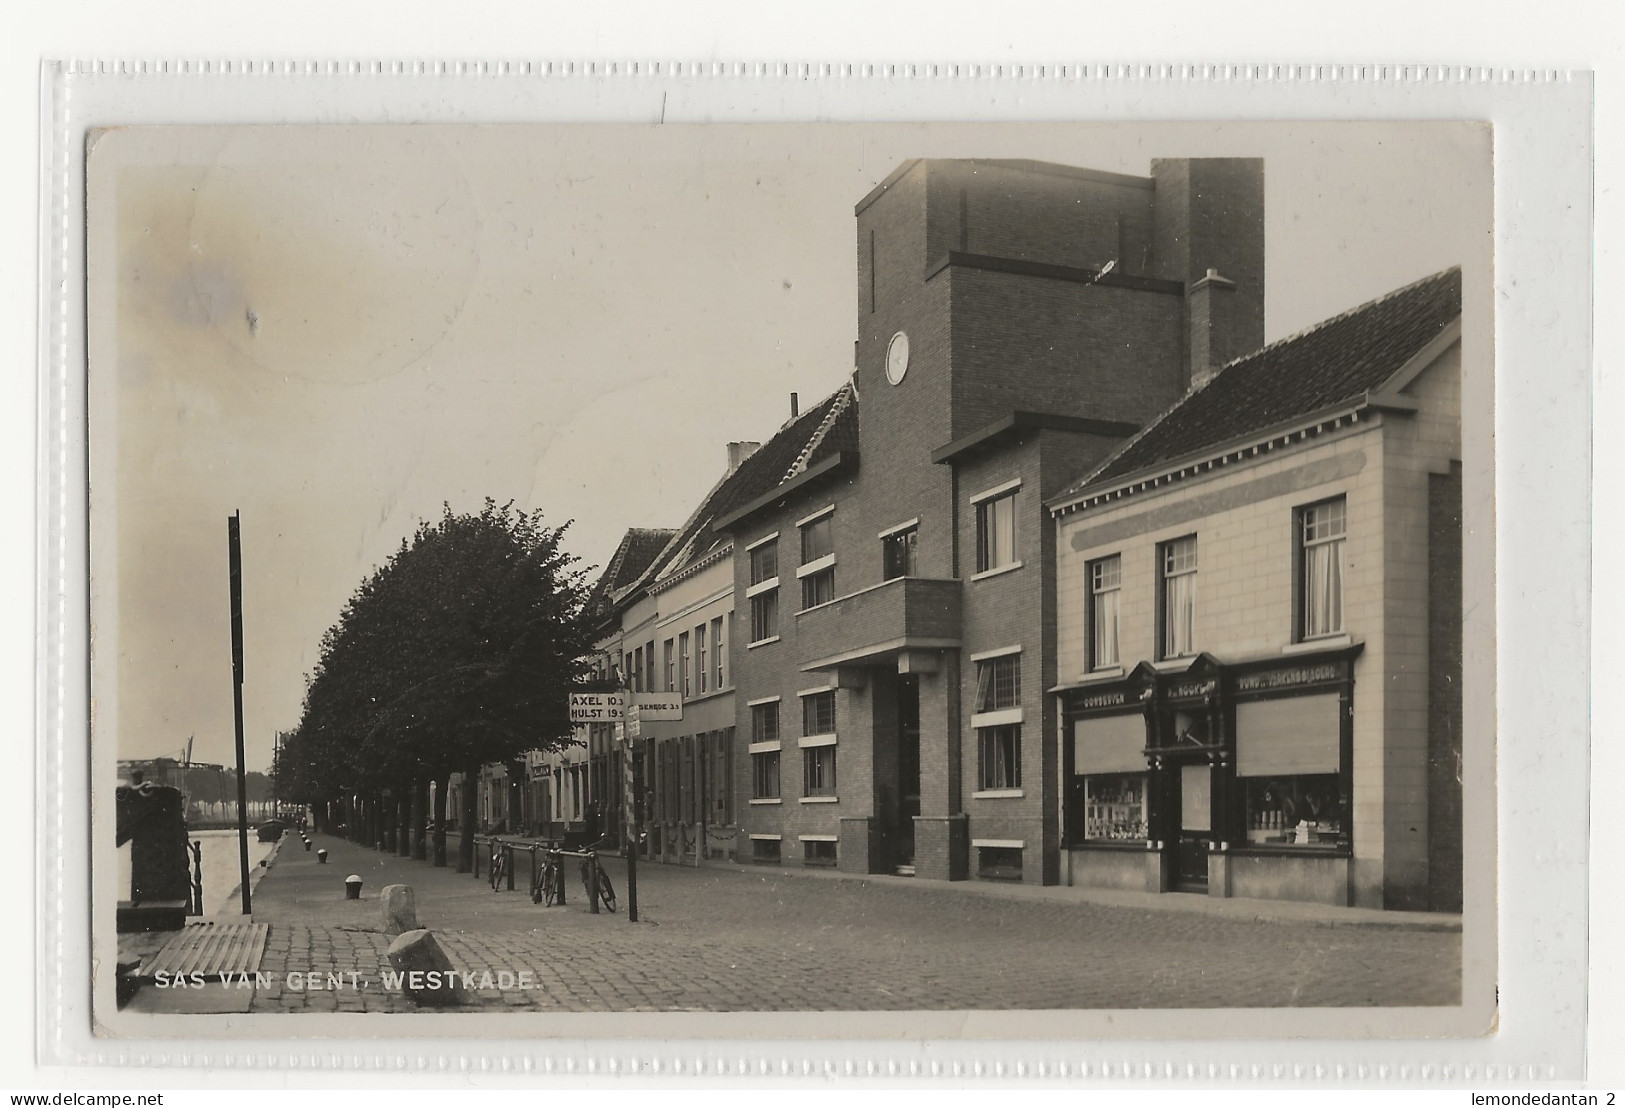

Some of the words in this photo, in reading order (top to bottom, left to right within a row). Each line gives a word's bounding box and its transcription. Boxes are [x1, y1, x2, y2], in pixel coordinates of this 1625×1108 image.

[571, 697, 603, 706] AXEL
[607, 696, 624, 706] 10.3
[571, 709, 603, 718] HULST
[607, 708, 624, 718] 19.5
